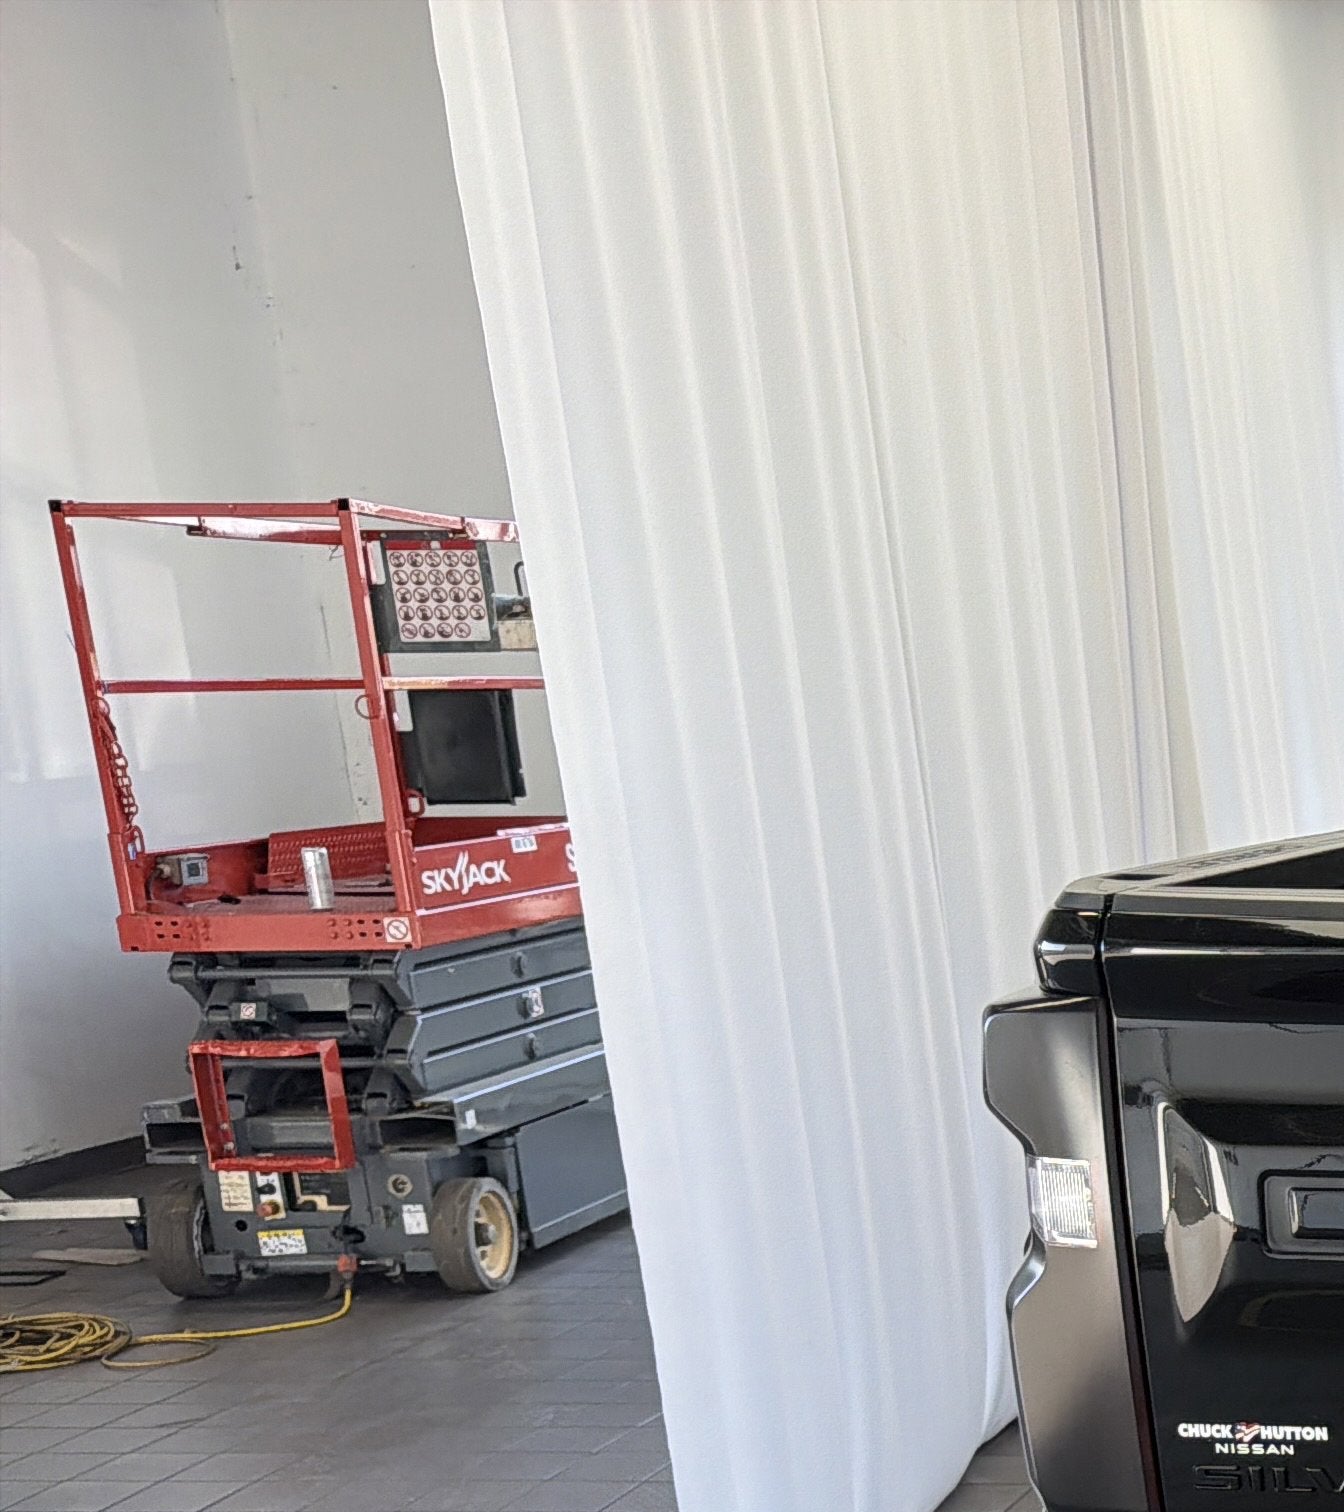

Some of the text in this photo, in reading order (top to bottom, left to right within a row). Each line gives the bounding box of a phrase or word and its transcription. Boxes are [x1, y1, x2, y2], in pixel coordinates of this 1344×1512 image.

[421, 850, 511, 895] SKYJACK
[1178, 1422, 1328, 1441] CHUCK HUTTON
[1215, 1442, 1294, 1455] NISSAN
